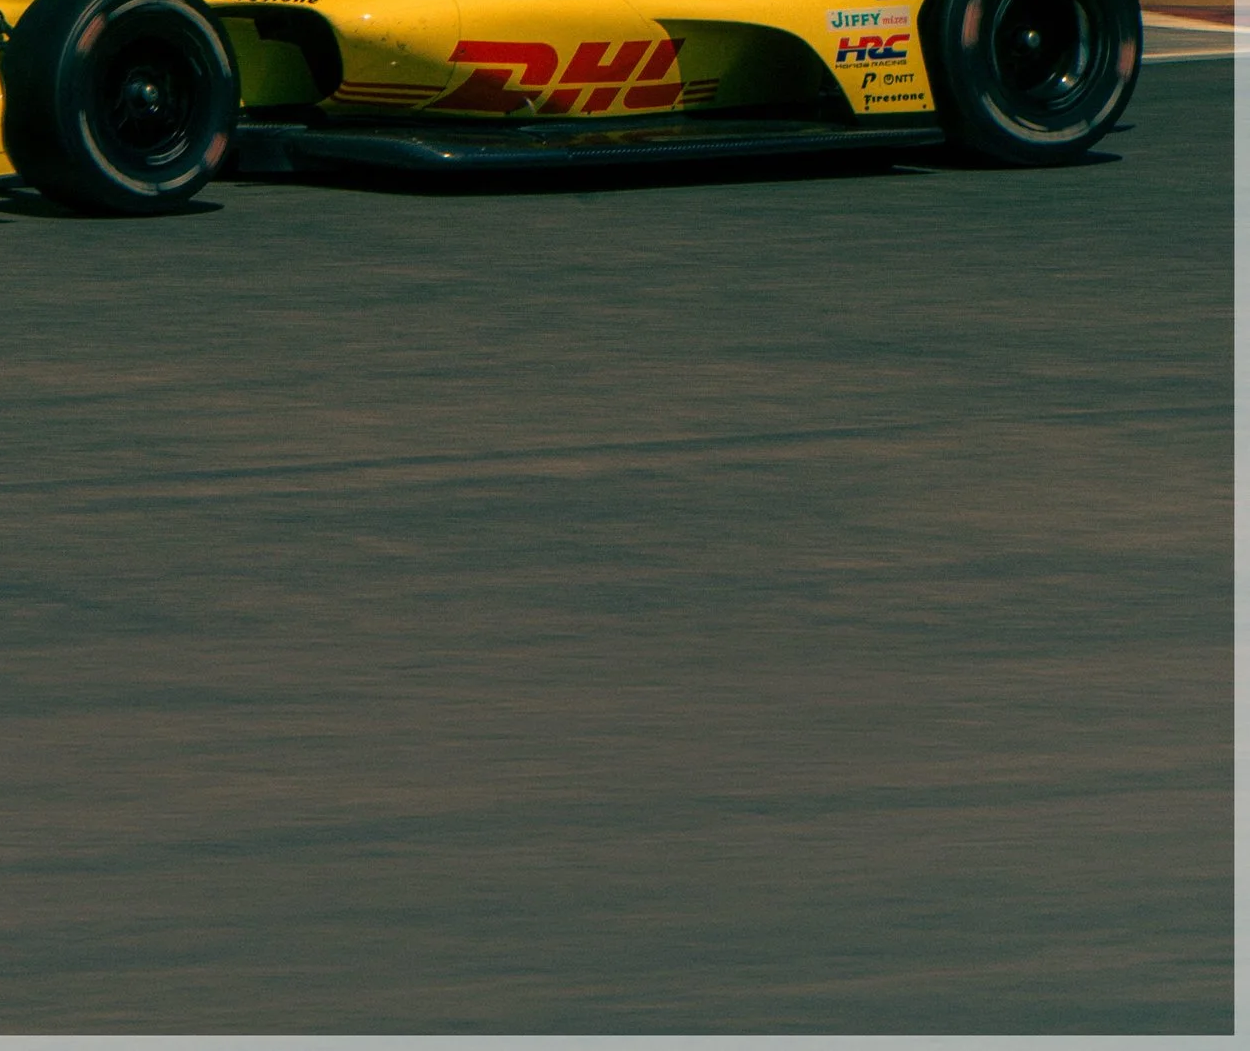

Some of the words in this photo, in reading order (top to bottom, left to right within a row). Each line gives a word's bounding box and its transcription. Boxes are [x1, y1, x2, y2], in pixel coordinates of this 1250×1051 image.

[836, 34, 910, 62] HRC
[428, 38, 686, 114] DHL
[893, 73, 915, 83] NTT
[863, 91, 925, 105] Firestone
